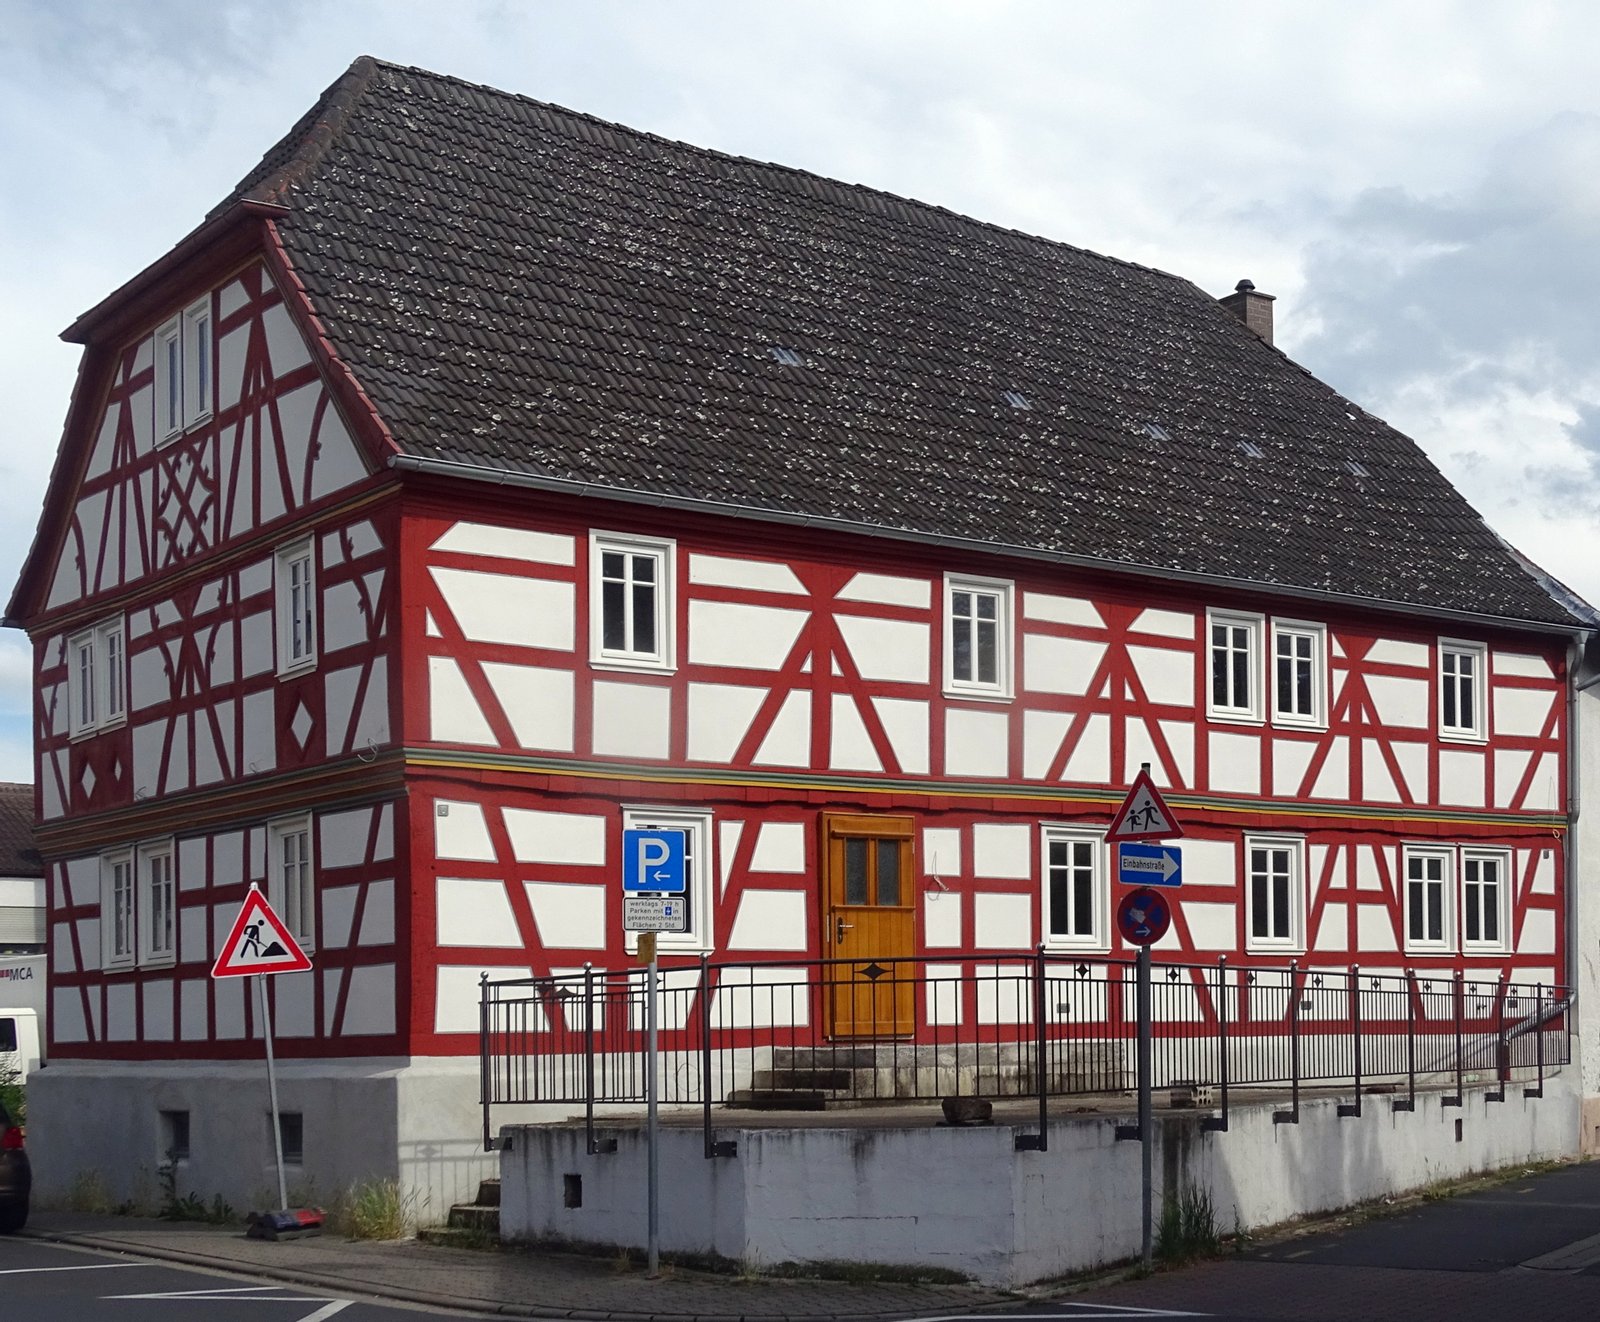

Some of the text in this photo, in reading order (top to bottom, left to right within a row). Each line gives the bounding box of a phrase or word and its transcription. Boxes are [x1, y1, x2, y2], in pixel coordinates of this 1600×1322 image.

[638, 838, 670, 883] P
[1123, 858, 1165, 870] Einbahnstraße
[10, 966, 33, 981] MCA
